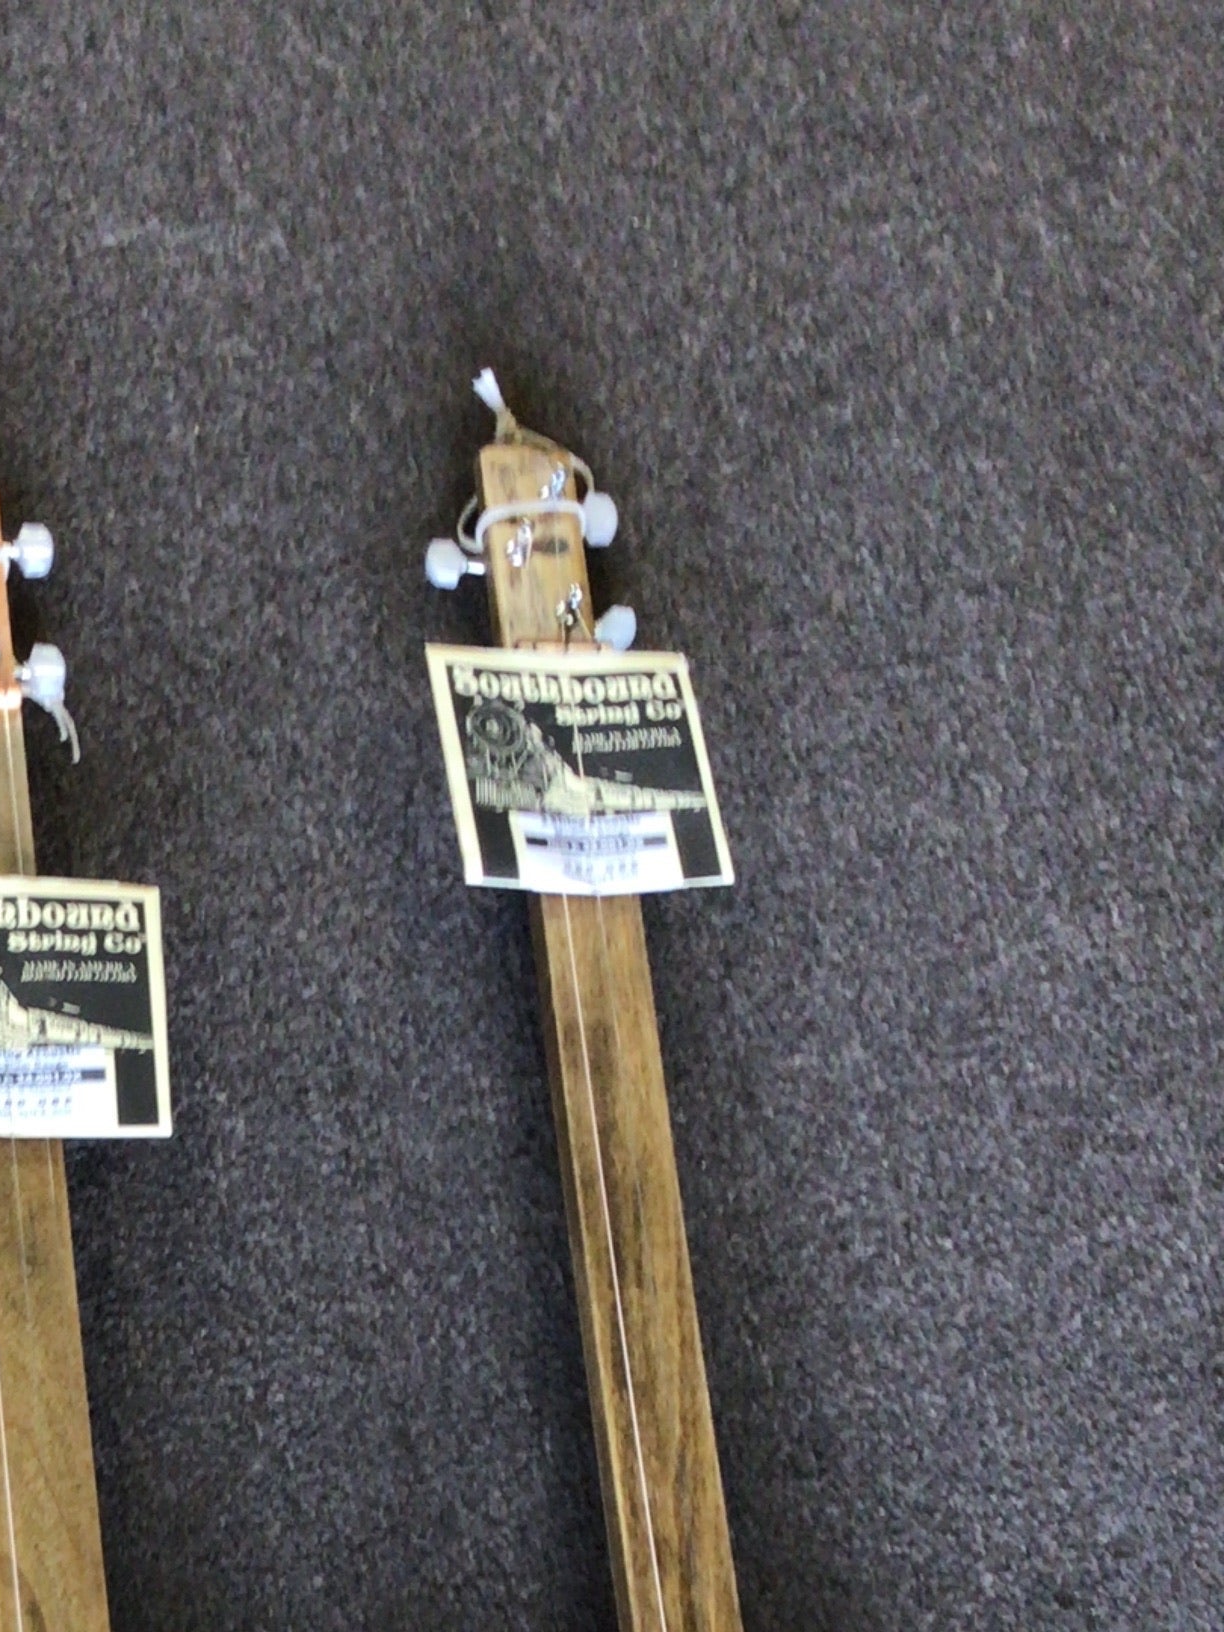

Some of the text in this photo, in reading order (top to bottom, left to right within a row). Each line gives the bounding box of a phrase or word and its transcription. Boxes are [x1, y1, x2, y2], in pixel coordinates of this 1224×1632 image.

[452, 664, 678, 704] Southbound
[555, 701, 640, 726] String
[6, 929, 142, 956] String Co
